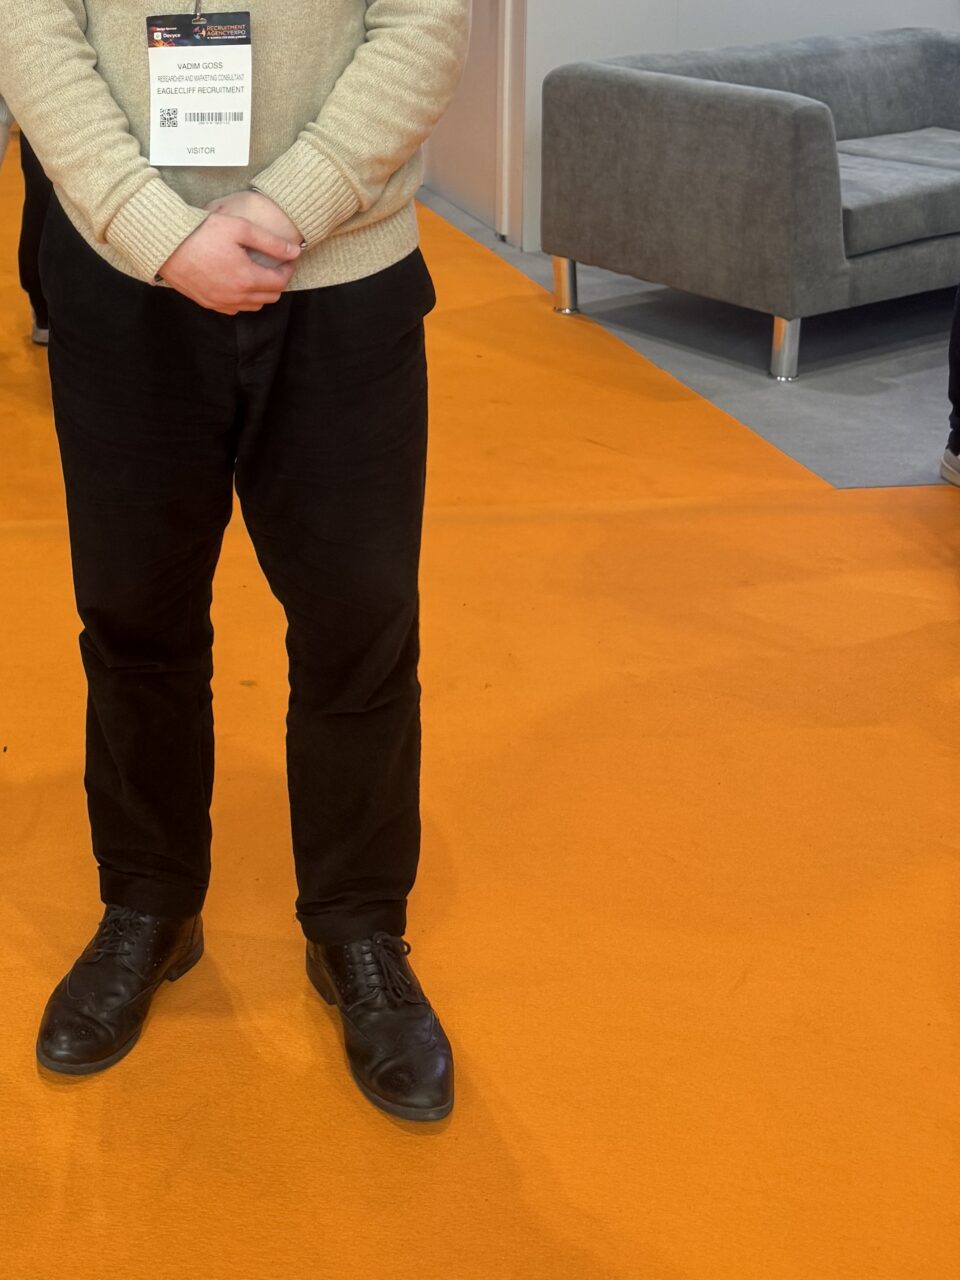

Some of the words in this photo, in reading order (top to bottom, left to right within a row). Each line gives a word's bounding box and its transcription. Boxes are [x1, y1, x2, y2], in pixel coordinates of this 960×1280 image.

[177, 62, 200, 70] VADIM
[202, 61, 223, 70] GOSS
[157, 87, 196, 95] EAGLECLIFF
[198, 86, 244, 94] RECRUITMENT
[187, 147, 215, 155] VISITOR
